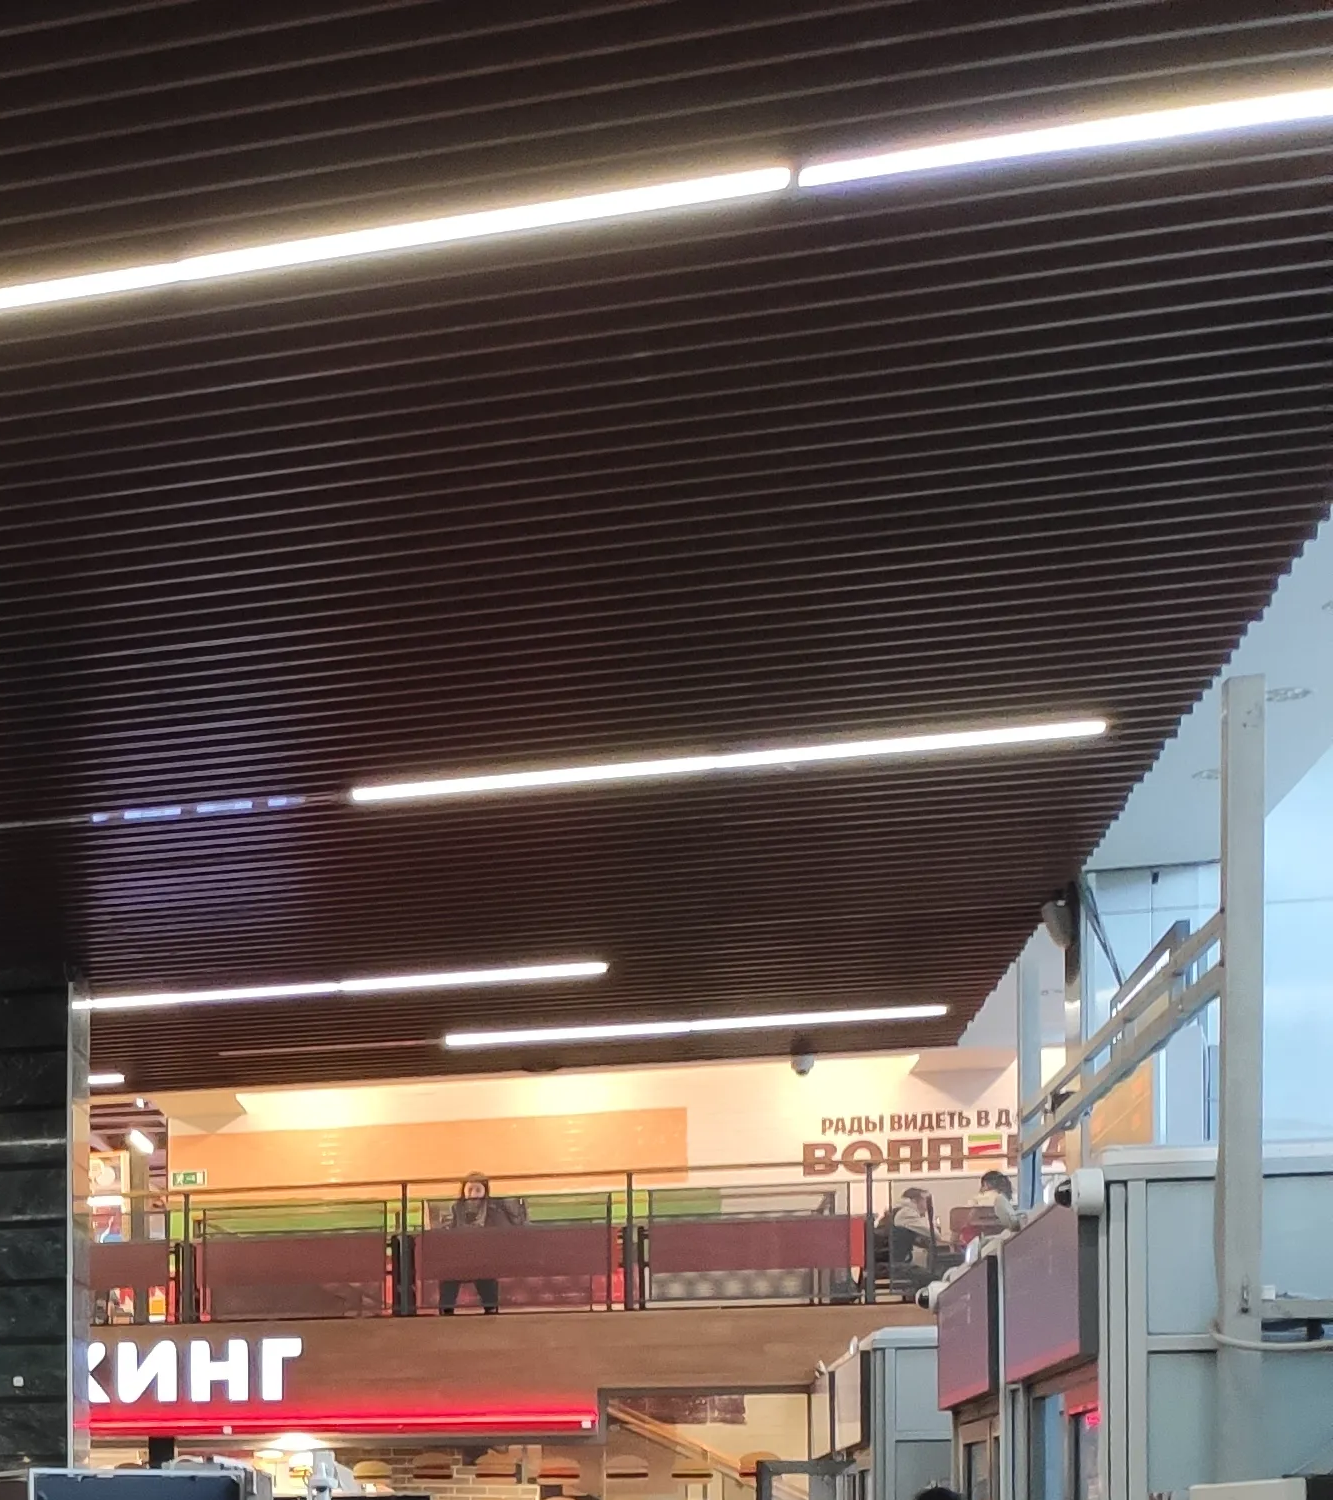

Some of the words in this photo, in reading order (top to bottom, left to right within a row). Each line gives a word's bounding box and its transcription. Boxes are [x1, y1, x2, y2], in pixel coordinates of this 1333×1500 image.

[821, 1115, 884, 1136] РАДЫ
[889, 1110, 972, 1133] ВИДЕТЬ
[976, 1109, 991, 1129] В
